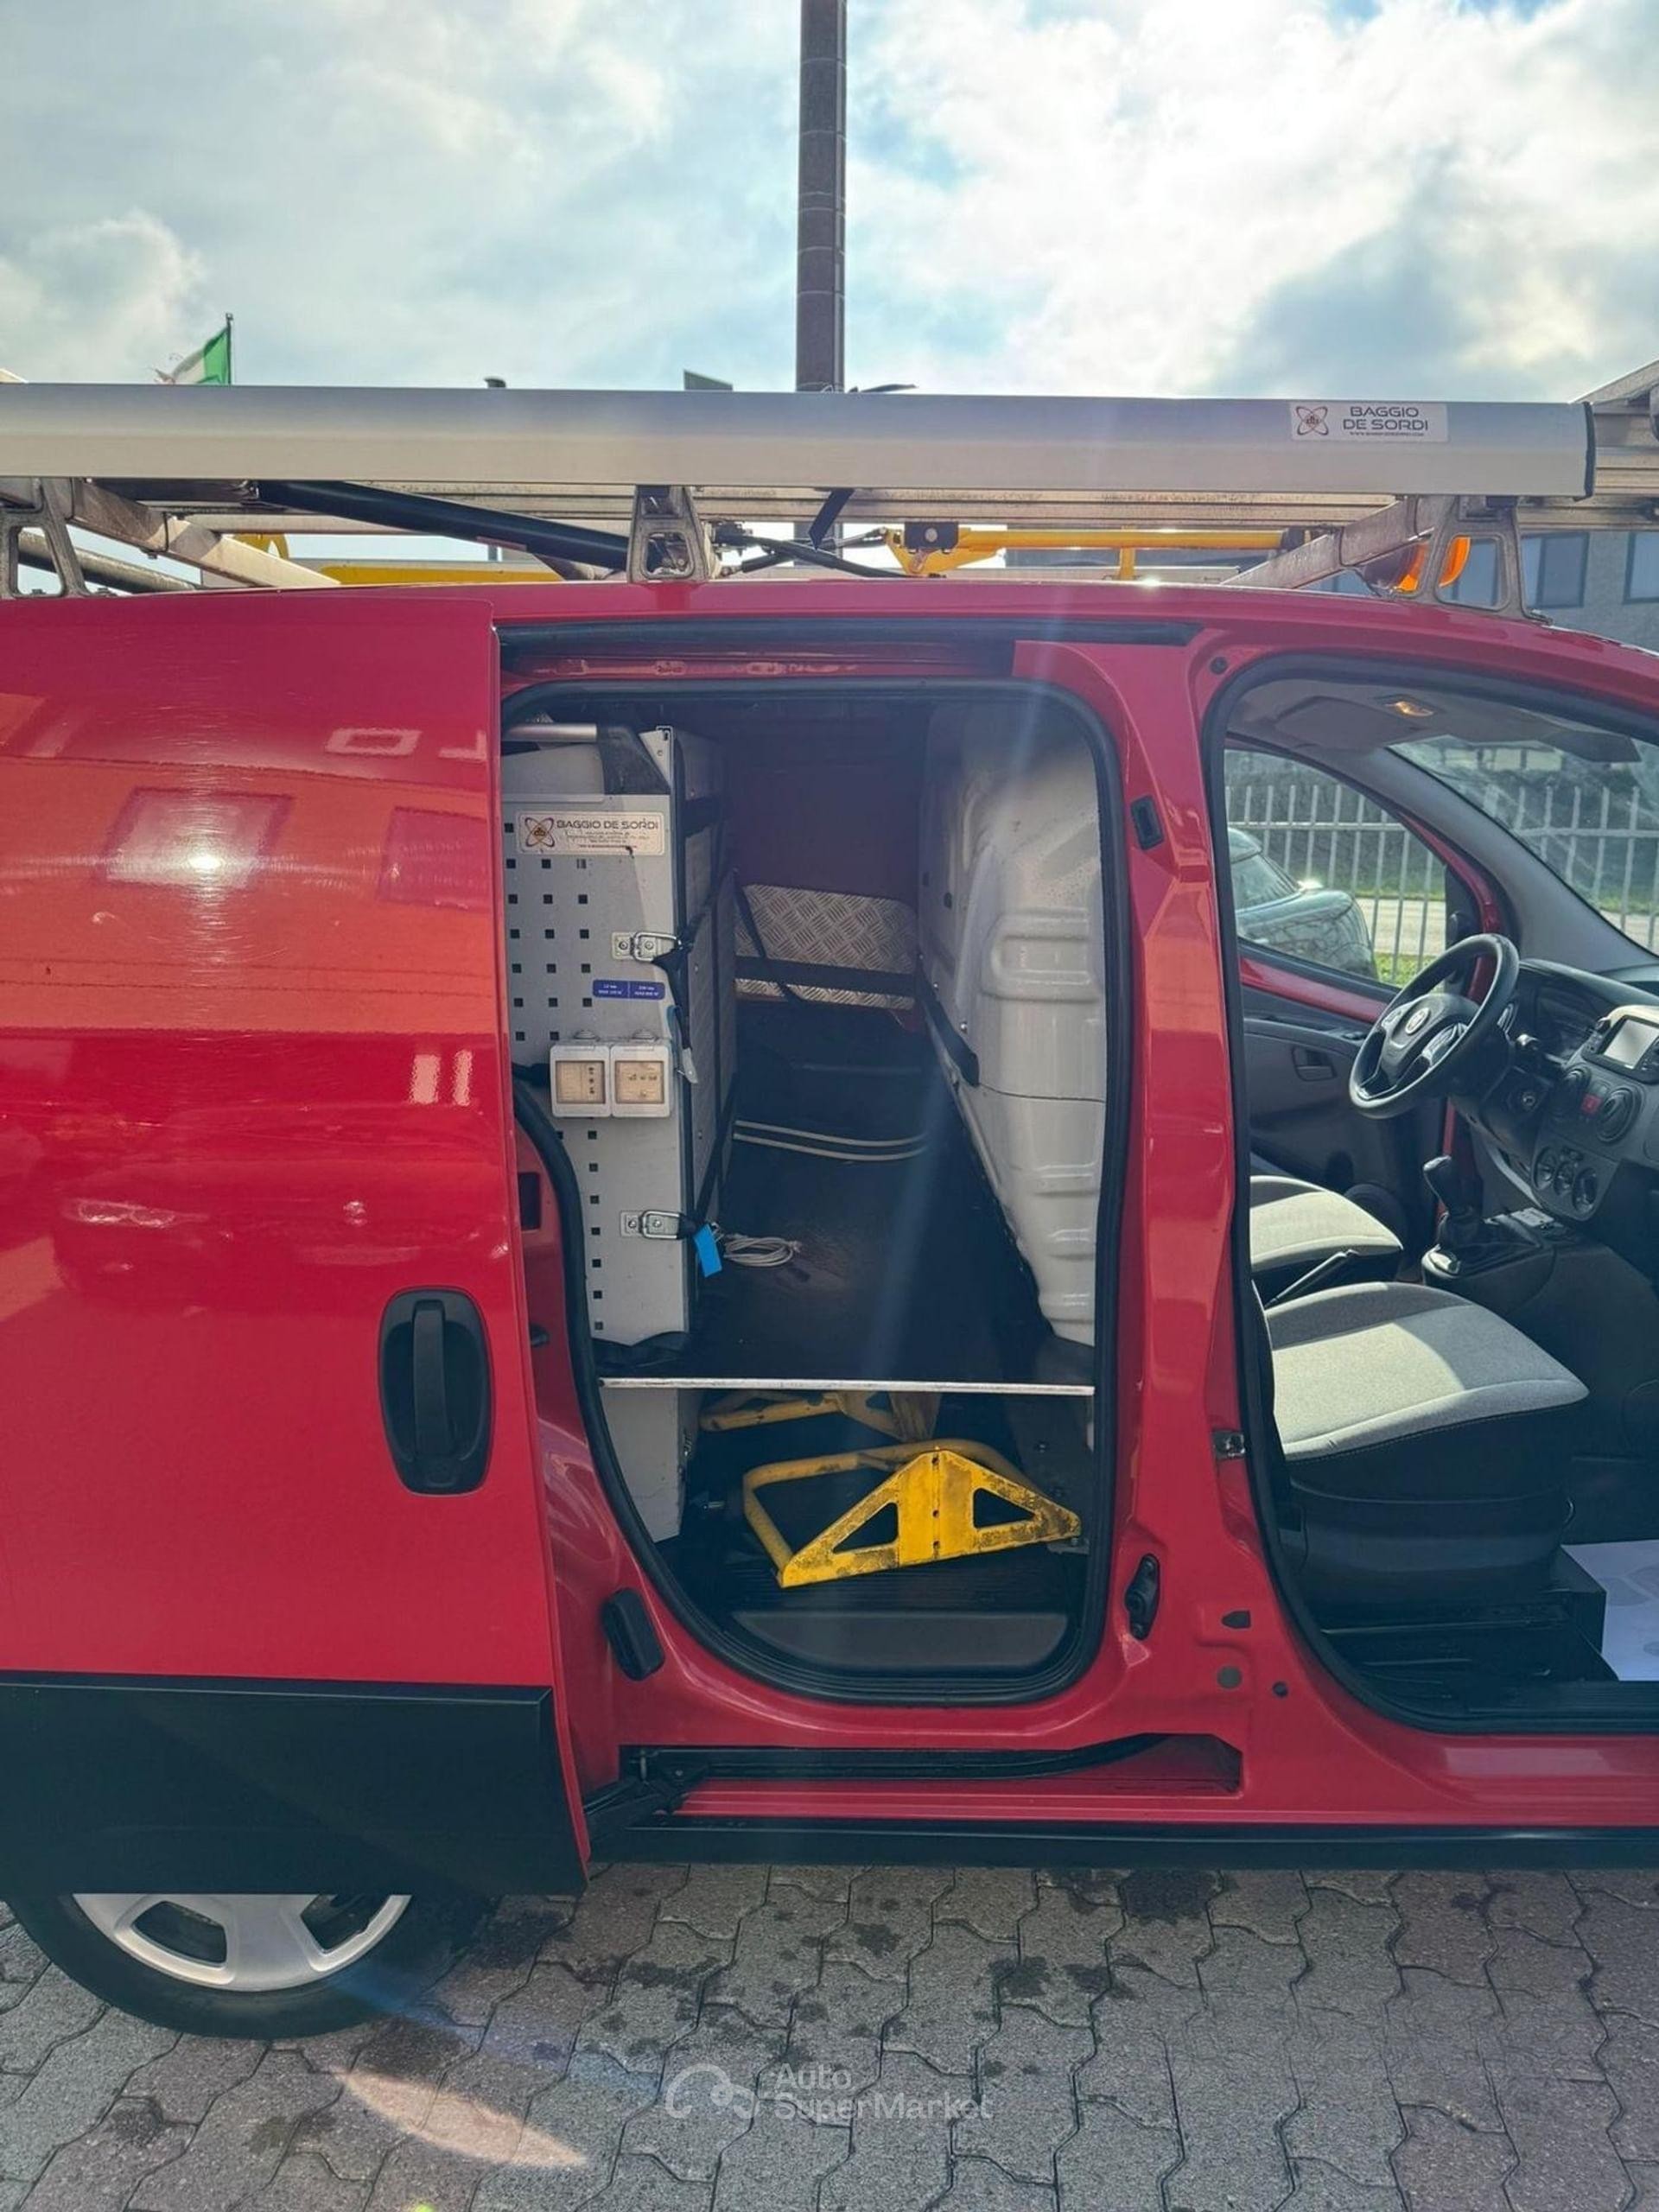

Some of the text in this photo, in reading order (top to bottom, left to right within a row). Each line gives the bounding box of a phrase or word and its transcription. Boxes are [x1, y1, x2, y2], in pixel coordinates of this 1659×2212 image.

[1350, 406, 1419, 417] BAGGIO
[1343, 418, 1428, 431] DE SORDI
[556, 820, 658, 830] BAGGIO DE SORDI
